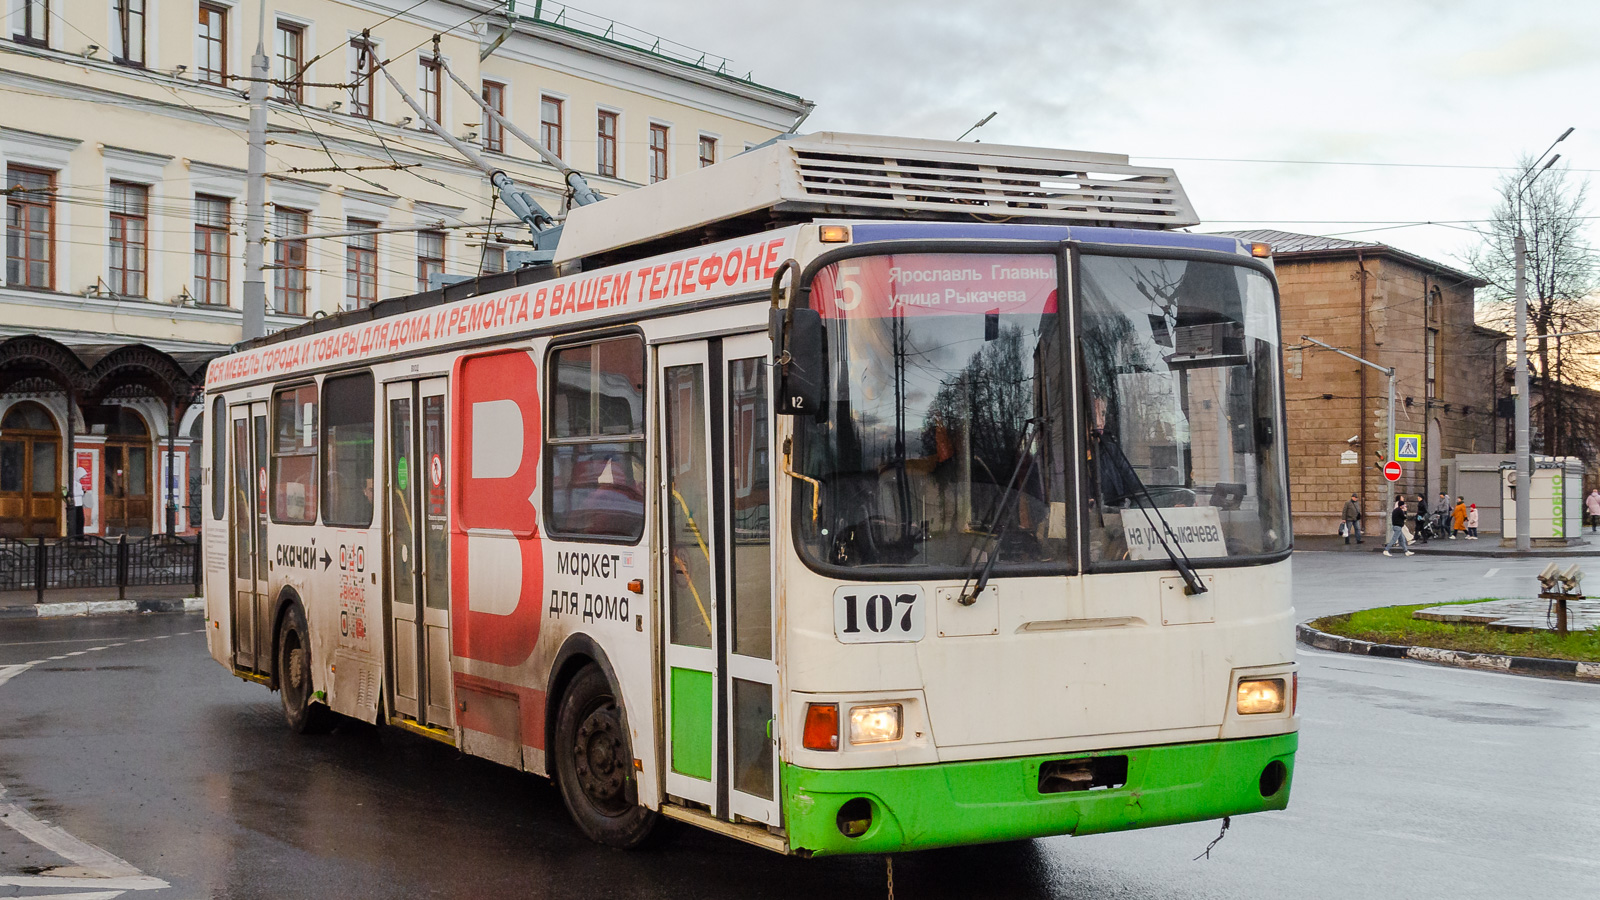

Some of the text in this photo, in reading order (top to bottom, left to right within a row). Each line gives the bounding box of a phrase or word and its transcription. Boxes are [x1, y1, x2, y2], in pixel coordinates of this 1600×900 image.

[834, 266, 863, 311] 5
[888, 266, 983, 286] Ярославль
[208, 237, 786, 385] ВСЯ МЕБЕЛЬ ГОРОДА И ТОВАРЫ ДЛЯ ДОМА И РЕМОНТА В ВАШЕМ ТЕЛЕФОНЕ
[888, 289, 1026, 310] улица Рыкачева
[1552, 474, 1563, 537] УДОБНО
[276, 537, 317, 570] скачай
[1128, 527, 1144, 545] на
[557, 551, 620, 586] маркет
[549, 589, 629, 624] для дома
[843, 593, 917, 633] 107
